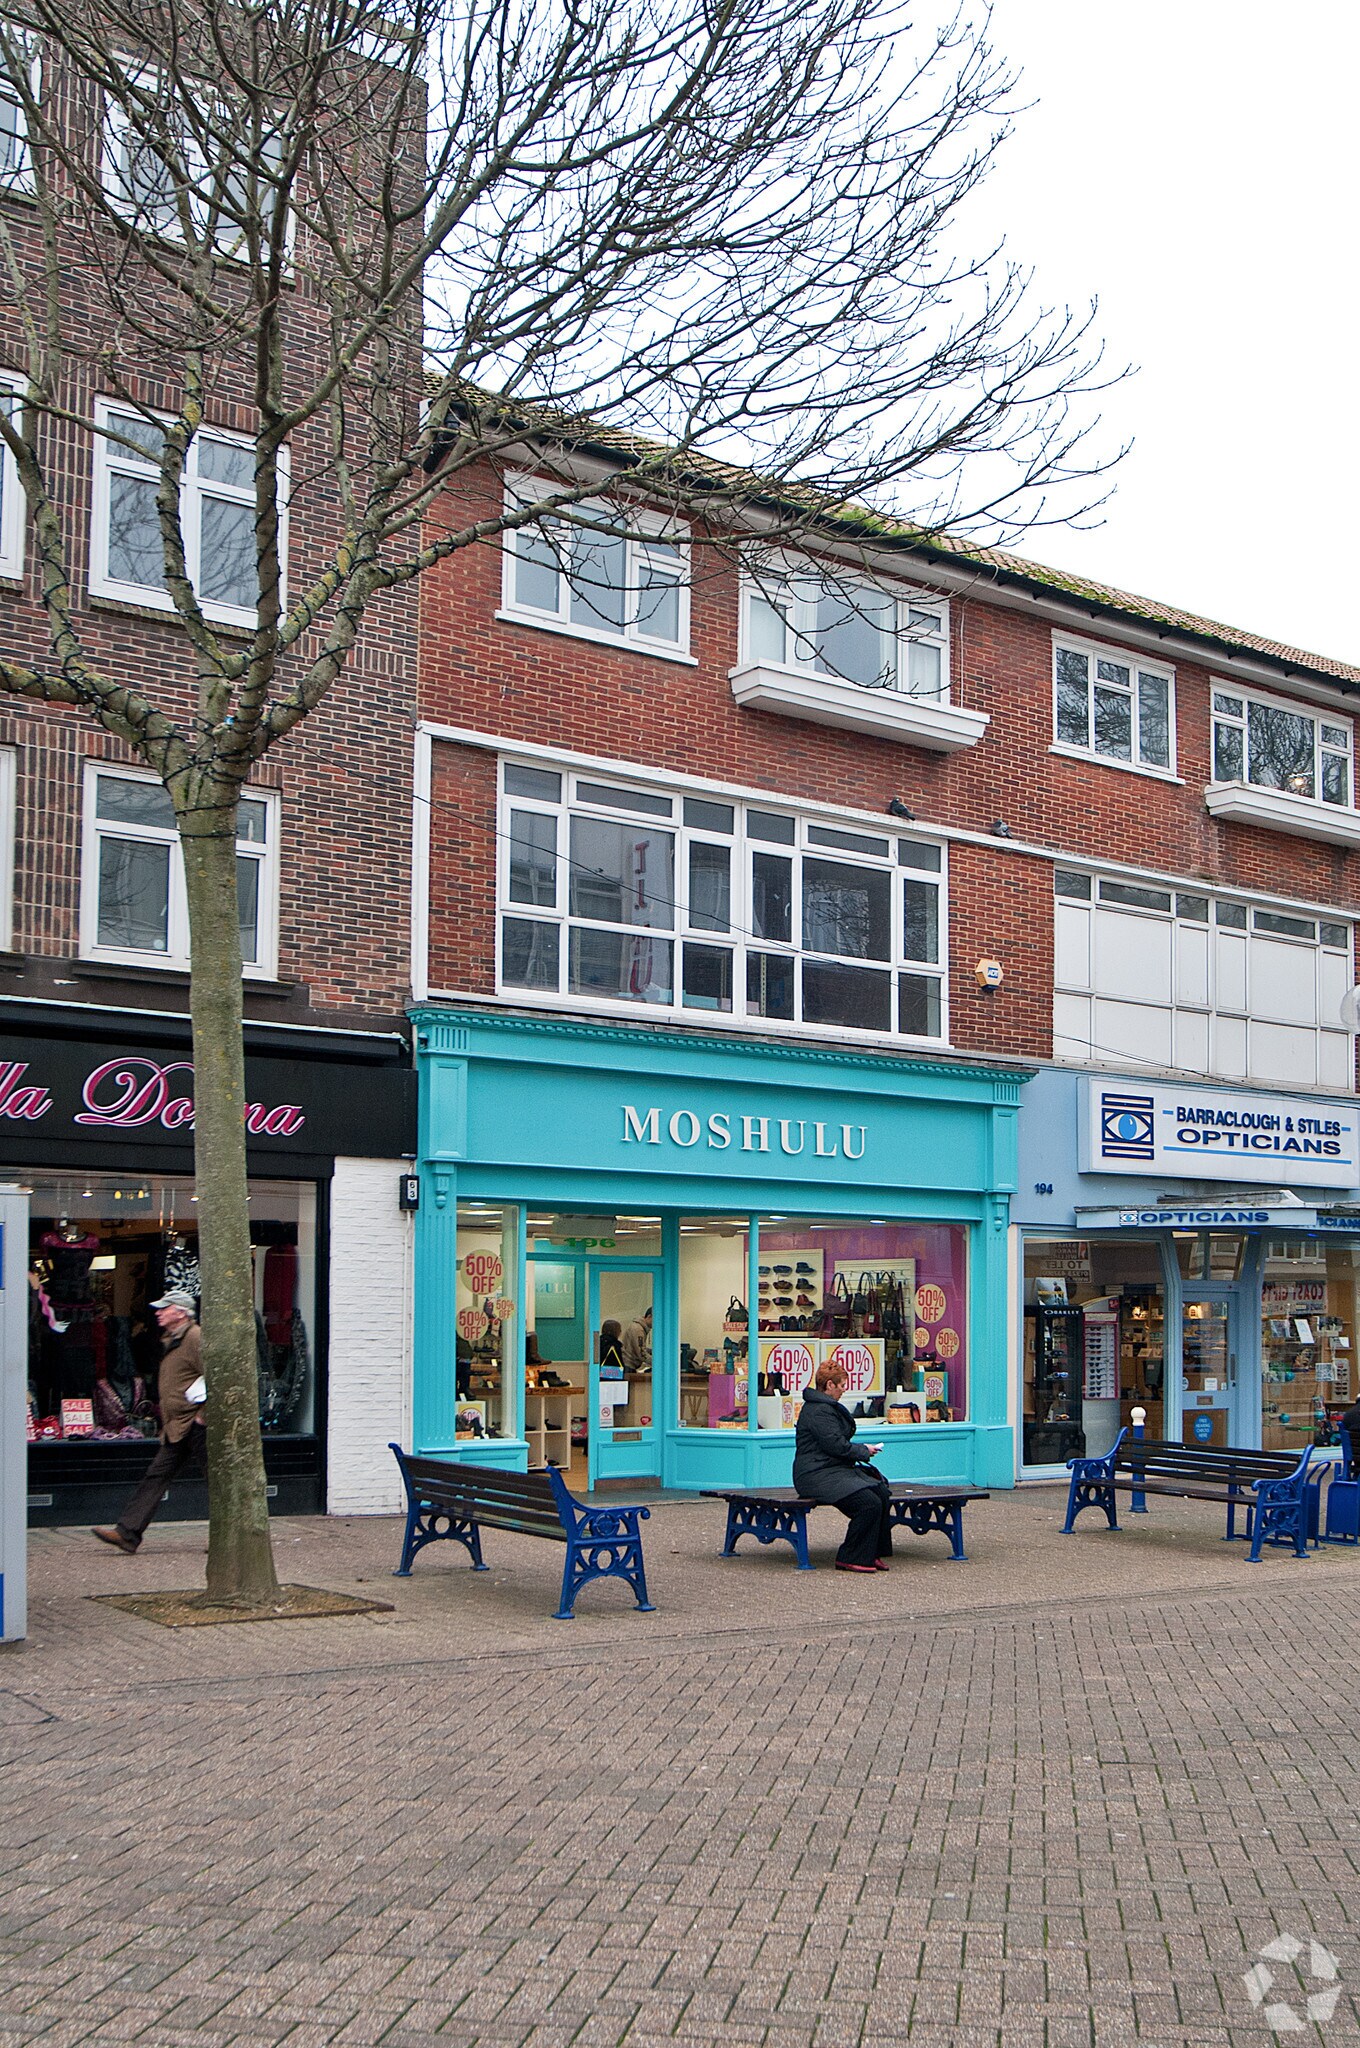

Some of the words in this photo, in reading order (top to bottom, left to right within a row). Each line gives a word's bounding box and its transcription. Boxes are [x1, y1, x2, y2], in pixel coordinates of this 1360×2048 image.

[0, 1062, 54, 1120] la
[74, 1057, 306, 1136] Dona
[1176, 1106, 1281, 1131] BARRACLOUGH
[1285, 1116, 1294, 1132] &
[1298, 1117, 1341, 1137] STILES
[620, 1105, 868, 1159] MOSHULU
[1176, 1128, 1342, 1155] OPTICIANS
[1034, 1183, 1054, 1195] 194
[1140, 1211, 1270, 1224] OPTICIANS
[563, 1237, 616, 1248] 196
[466, 1255, 502, 1276] 50%
[472, 1276, 495, 1293] OFF
[918, 1289, 944, 1307] 50%
[496, 1300, 514, 1310] 50%
[459, 1311, 486, 1327] 50%
[500, 1310, 511, 1320] OFF
[922, 1307, 939, 1321] OFF
[464, 1327, 481, 1340] OFF
[938, 1332, 958, 1345] 50%
[941, 1345, 954, 1356] OFF
[773, 1349, 808, 1372] 50%
[836, 1349, 870, 1373] 50%
[926, 1381, 942, 1389] 50%
[928, 1389, 940, 1397] OFF
[63, 1401, 92, 1411] SALE
[64, 1413, 92, 1422] SALE
[64, 1425, 92, 1436] SALE
